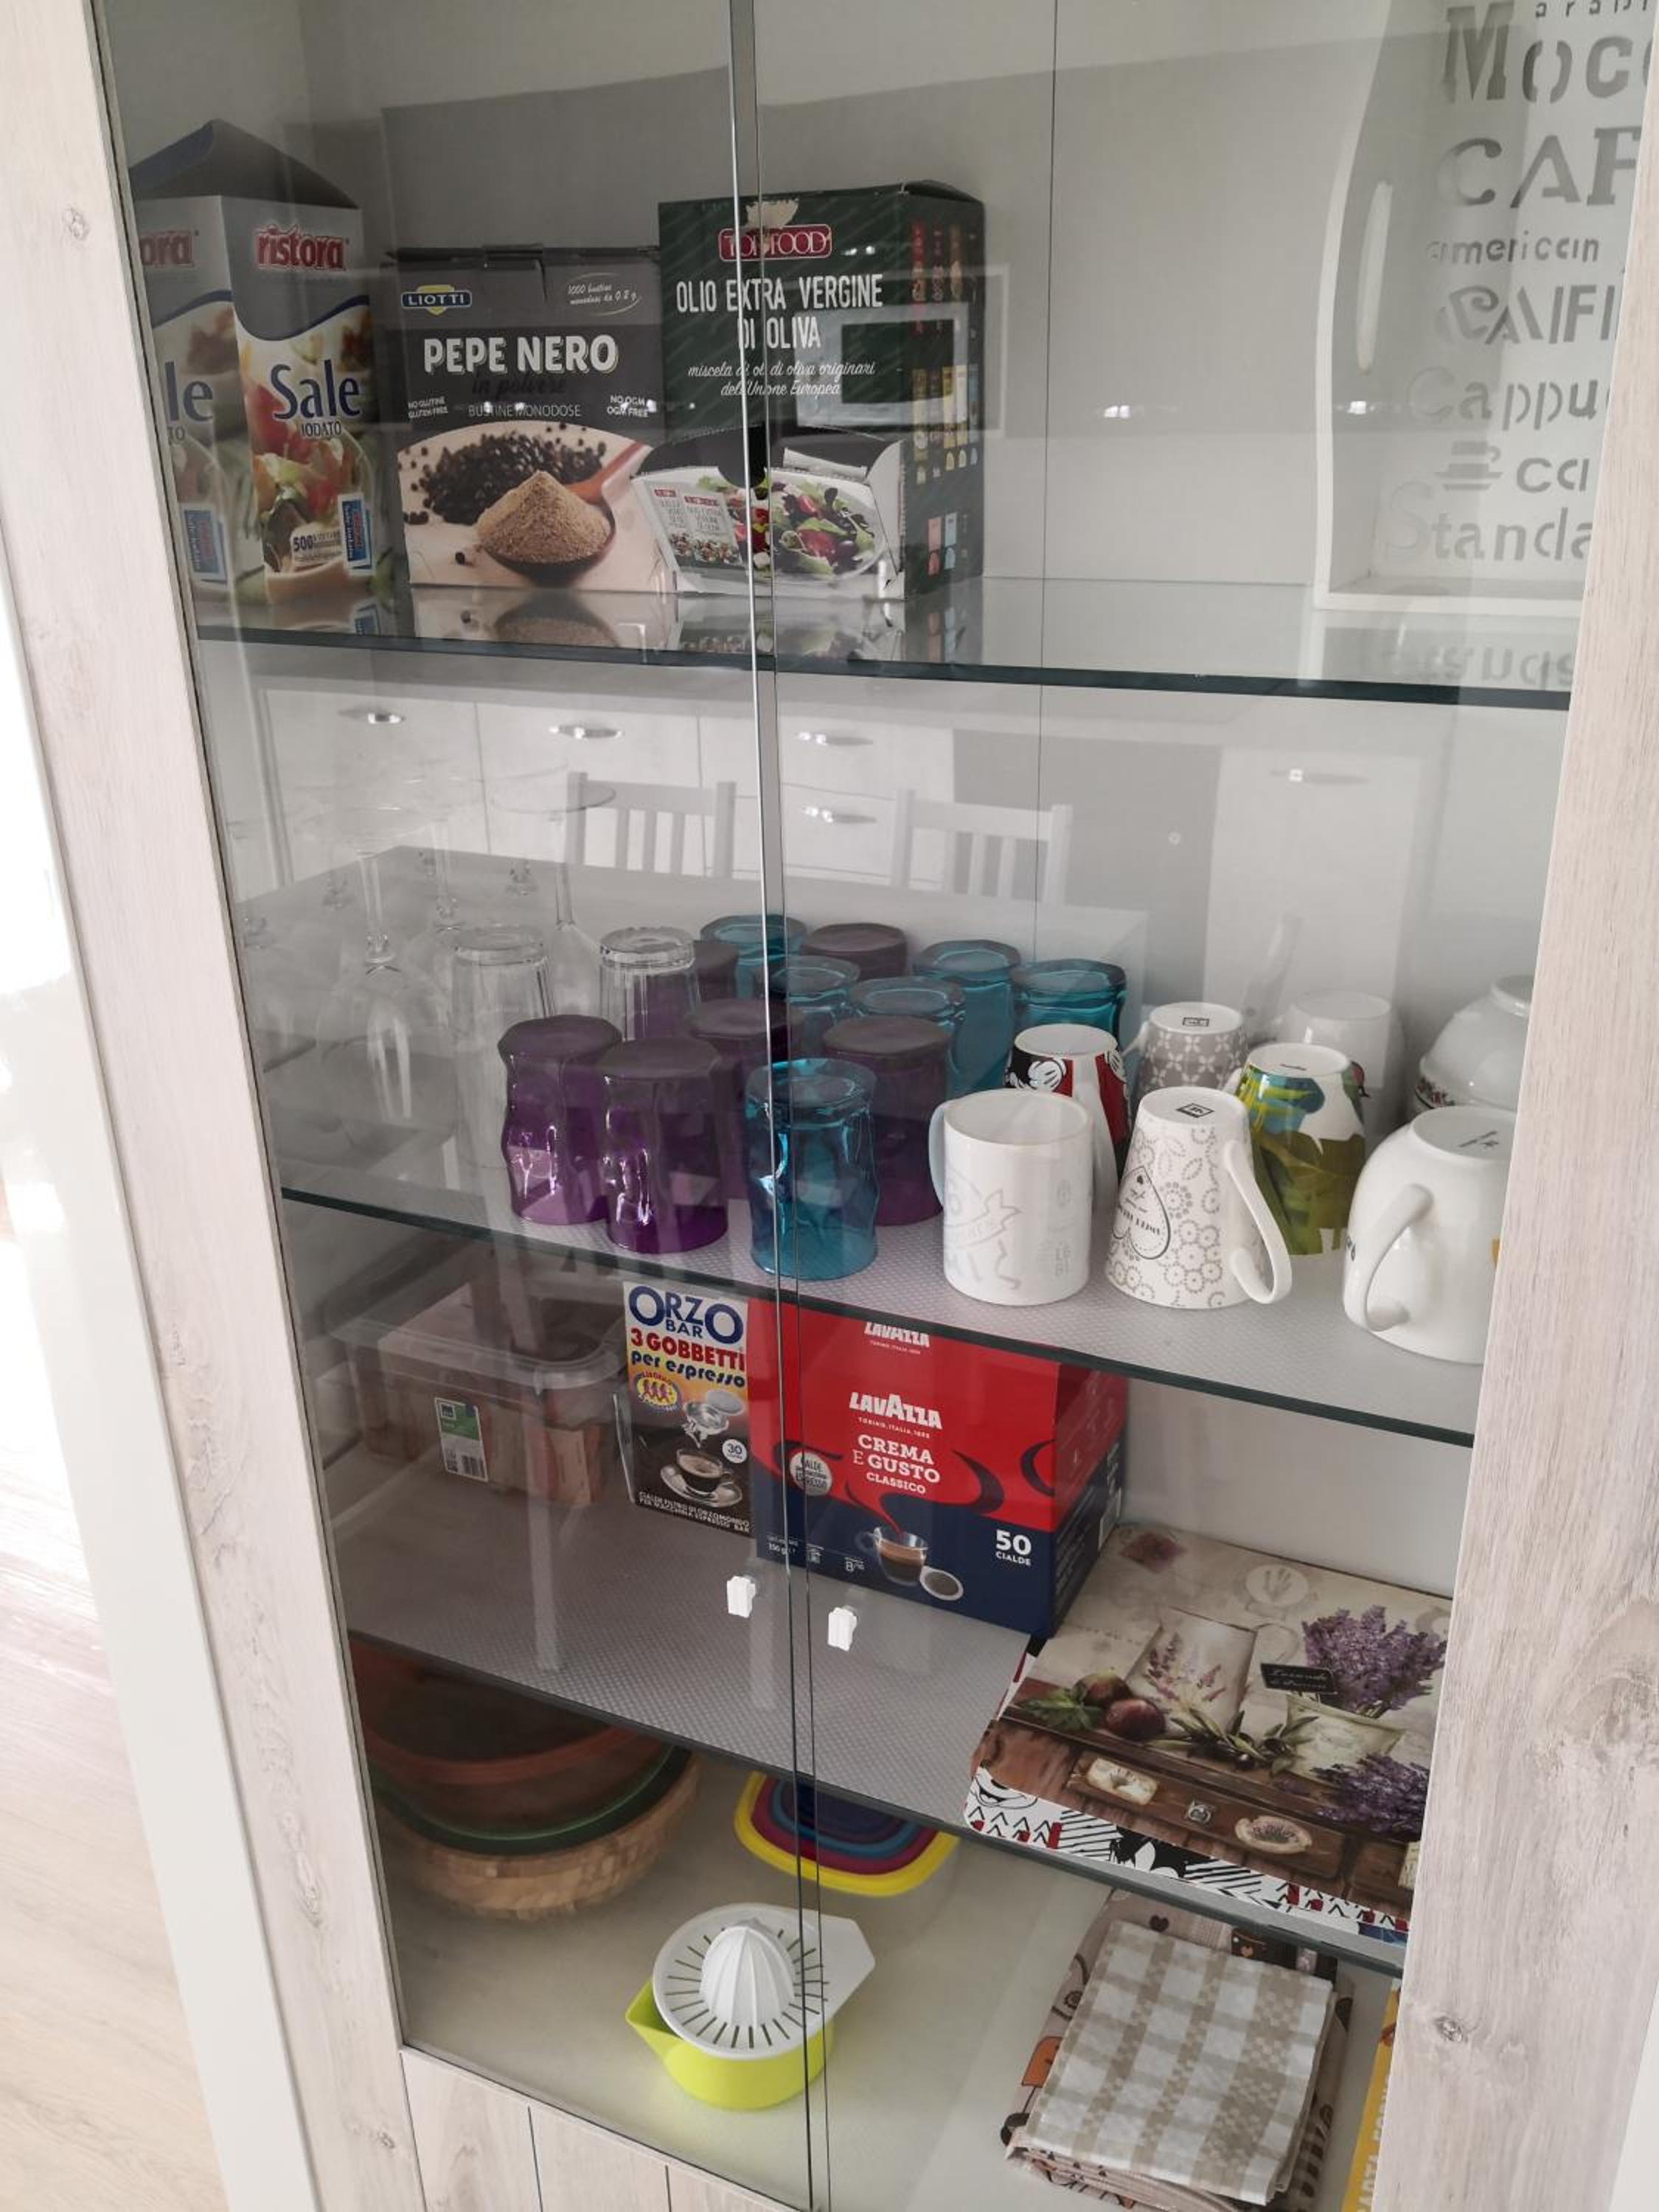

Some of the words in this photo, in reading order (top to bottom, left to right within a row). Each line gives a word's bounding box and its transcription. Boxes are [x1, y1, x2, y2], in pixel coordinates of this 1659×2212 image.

[1443, 1, 1652, 104] MOC
[256, 224, 345, 271] ristora
[408, 294, 464, 306] LIOTTI
[676, 279, 717, 313] OLIO
[726, 277, 787, 313] EXTRA
[799, 274, 884, 309] VERGINE
[766, 315, 821, 349] OLIVA
[424, 337, 508, 375] PEPE
[518, 334, 619, 375] NERO
[269, 359, 362, 421] Sale
[1407, 366, 1610, 431] Cappu
[628, 1285, 745, 1345] ORZO
[666, 1319, 703, 1339] BAR
[630, 1327, 644, 1347] 3
[647, 1332, 746, 1372] GOBBETTI
[631, 1349, 661, 1369] per
[665, 1358, 746, 1388] espresso
[849, 1391, 943, 1430] LAVAZZA
[727, 1442, 742, 1455] 30
[852, 1449, 864, 1466] E
[867, 1454, 941, 1484] GUSTO
[858, 1434, 935, 1466] CREMA
[866, 1472, 927, 1495] CLASSICO
[995, 1529, 1032, 1556] 50
[995, 1550, 1032, 1567] CIALDE
